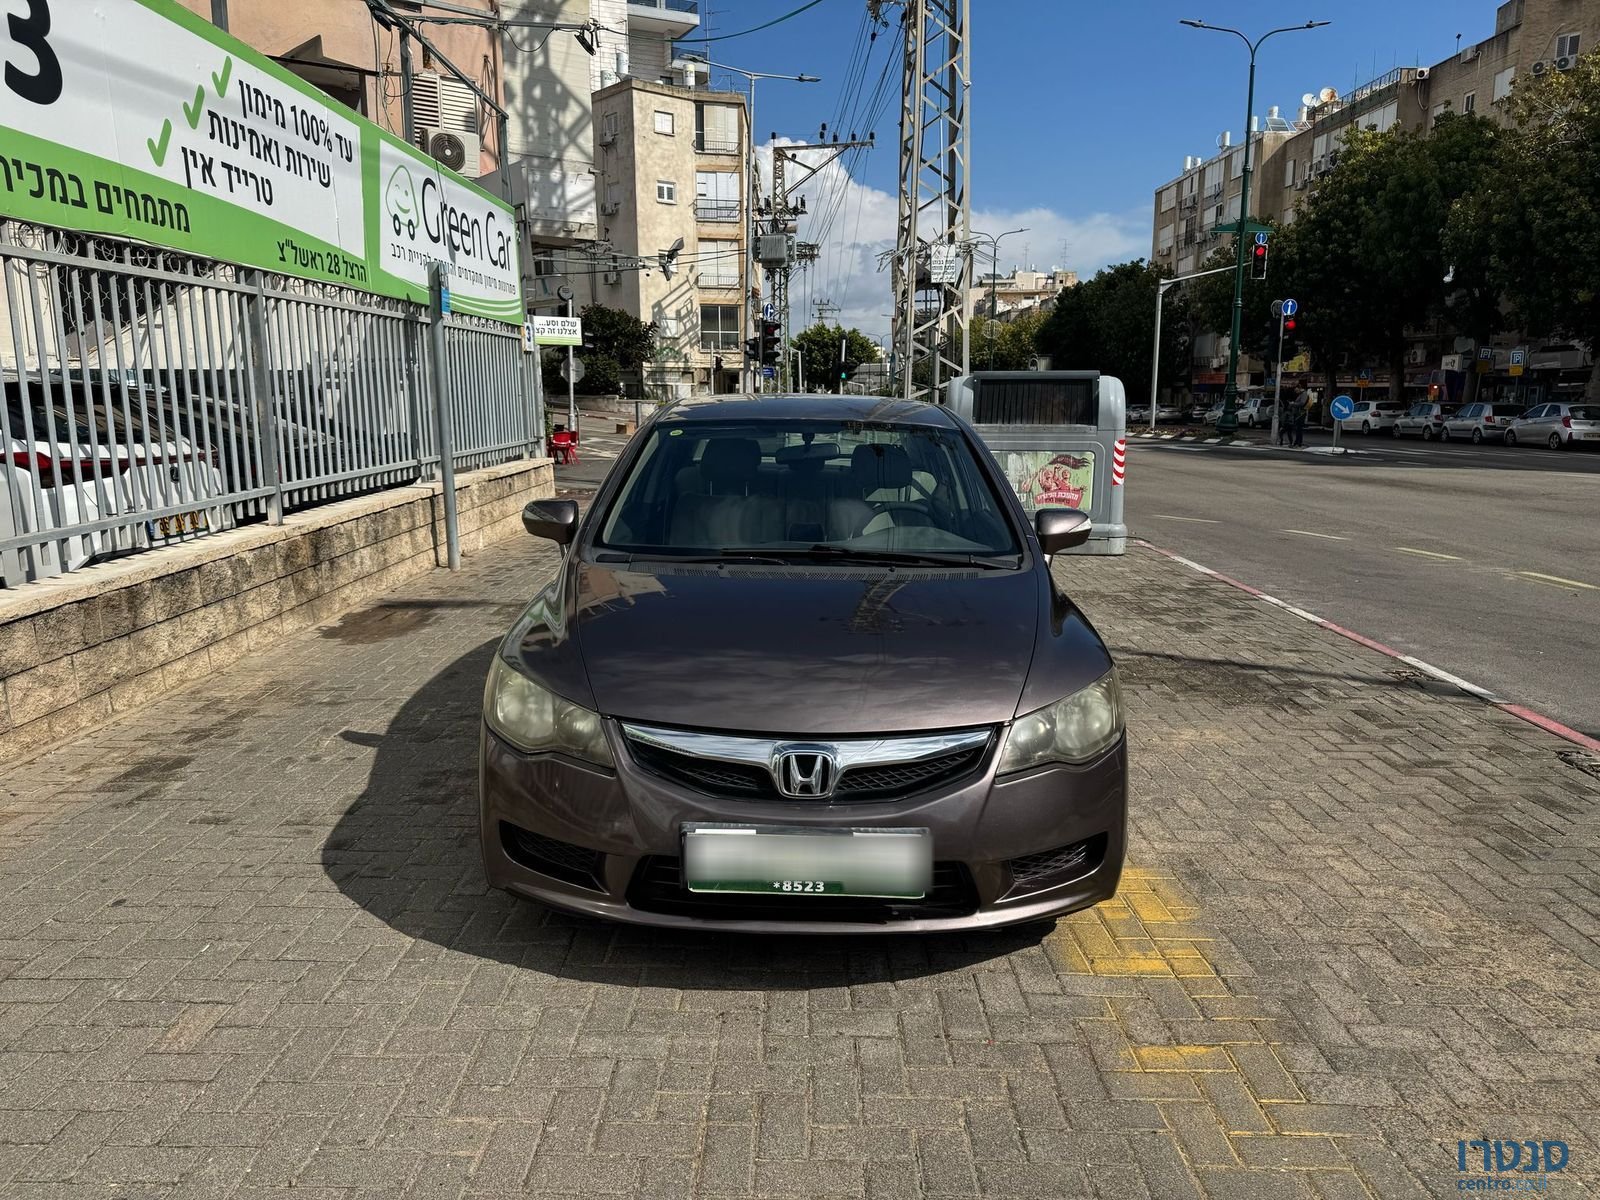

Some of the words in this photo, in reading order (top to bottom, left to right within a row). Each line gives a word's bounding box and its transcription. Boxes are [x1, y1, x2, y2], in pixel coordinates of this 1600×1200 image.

[238, 79, 287, 129] מימון
[207, 109, 281, 168] ואמינות
[290, 105, 333, 152] 100%
[335, 132, 353, 163] עד
[181, 146, 217, 189] אין
[221, 161, 274, 206] טרייד
[284, 145, 331, 188] שירות
[94, 180, 191, 233] מתמחים
[421, 177, 484, 261] Green
[485, 211, 511, 272] Car
[277, 238, 325, 271] ראשל"צ
[326, 252, 341, 276] 28
[342, 255, 367, 283] הרצל
[391, 243, 406, 261] רכב
[408, 248, 432, 271] לקניית
[457, 265, 483, 286] מתקדמים
[557, 327, 577, 335] אצלנו
